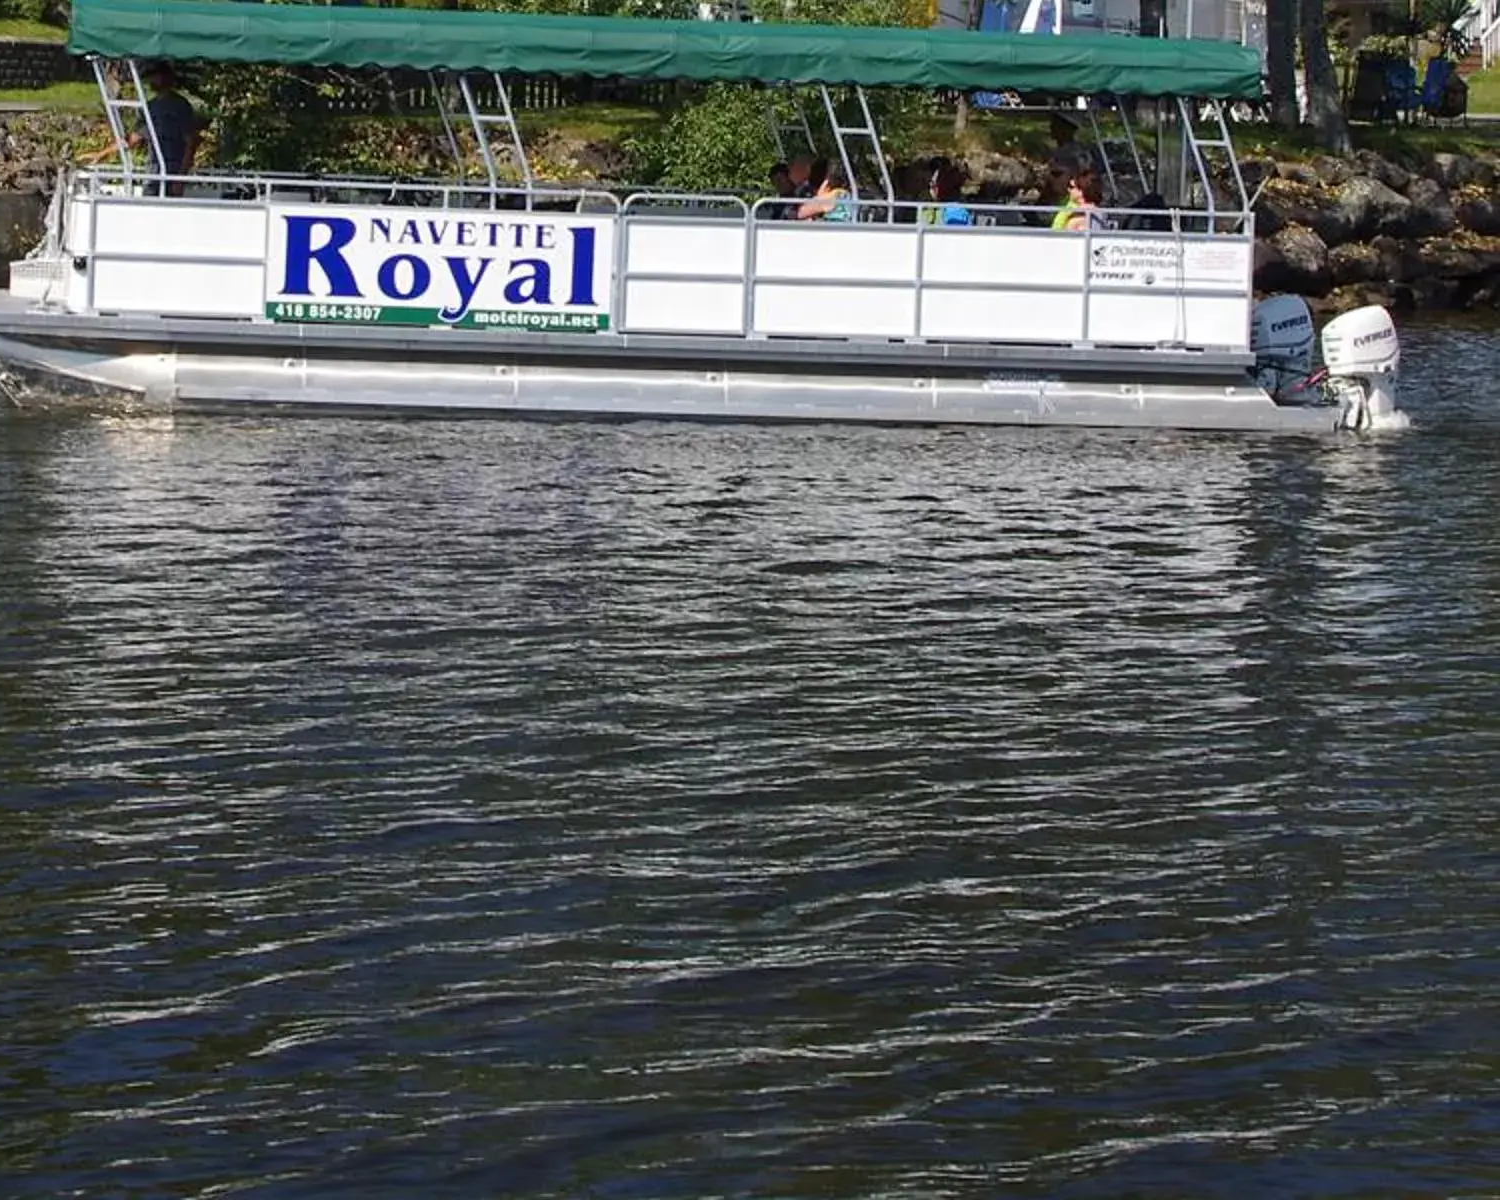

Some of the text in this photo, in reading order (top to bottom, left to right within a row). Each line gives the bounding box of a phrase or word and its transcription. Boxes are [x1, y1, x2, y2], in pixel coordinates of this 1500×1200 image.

[369, 218, 556, 249] NAVETTE
[281, 215, 599, 320] Royal
[275, 303, 382, 320] 418 854-2307
[473, 310, 599, 329] motelroyal.net
